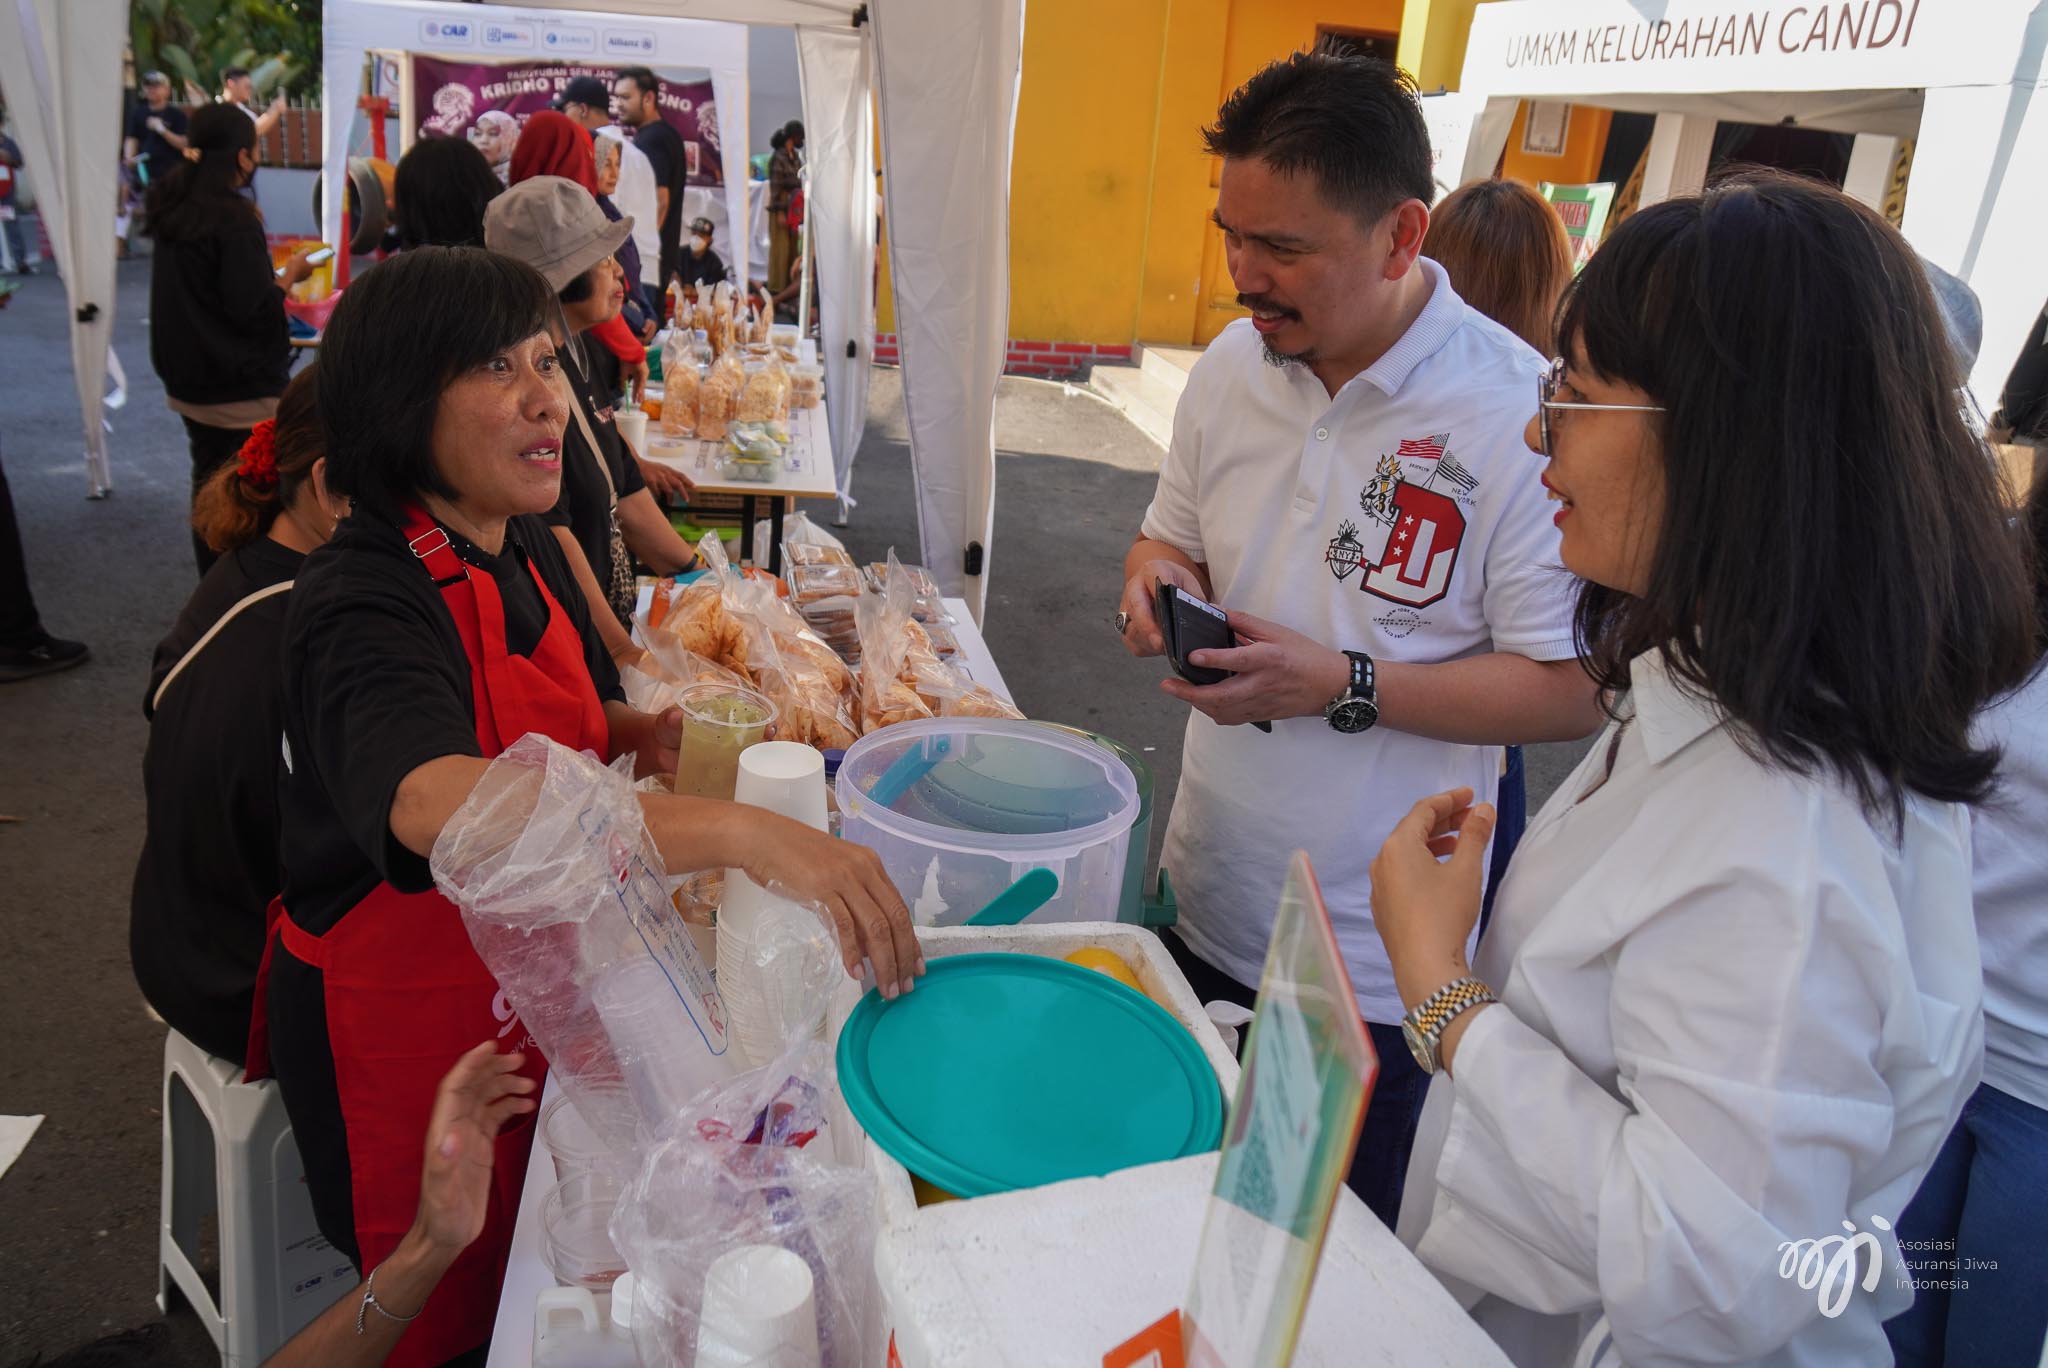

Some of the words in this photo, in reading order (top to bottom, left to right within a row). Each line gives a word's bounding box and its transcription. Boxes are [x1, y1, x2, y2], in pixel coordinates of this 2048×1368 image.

[1506, 30, 1578, 68] UMKM
[1583, 11, 1769, 65] KELURAHAN
[1777, 0, 1921, 55] CANDI
[480, 78, 549, 100] KRIDHO
[1451, 486, 1471, 497] NEW
[1456, 496, 1477, 507] YORK
